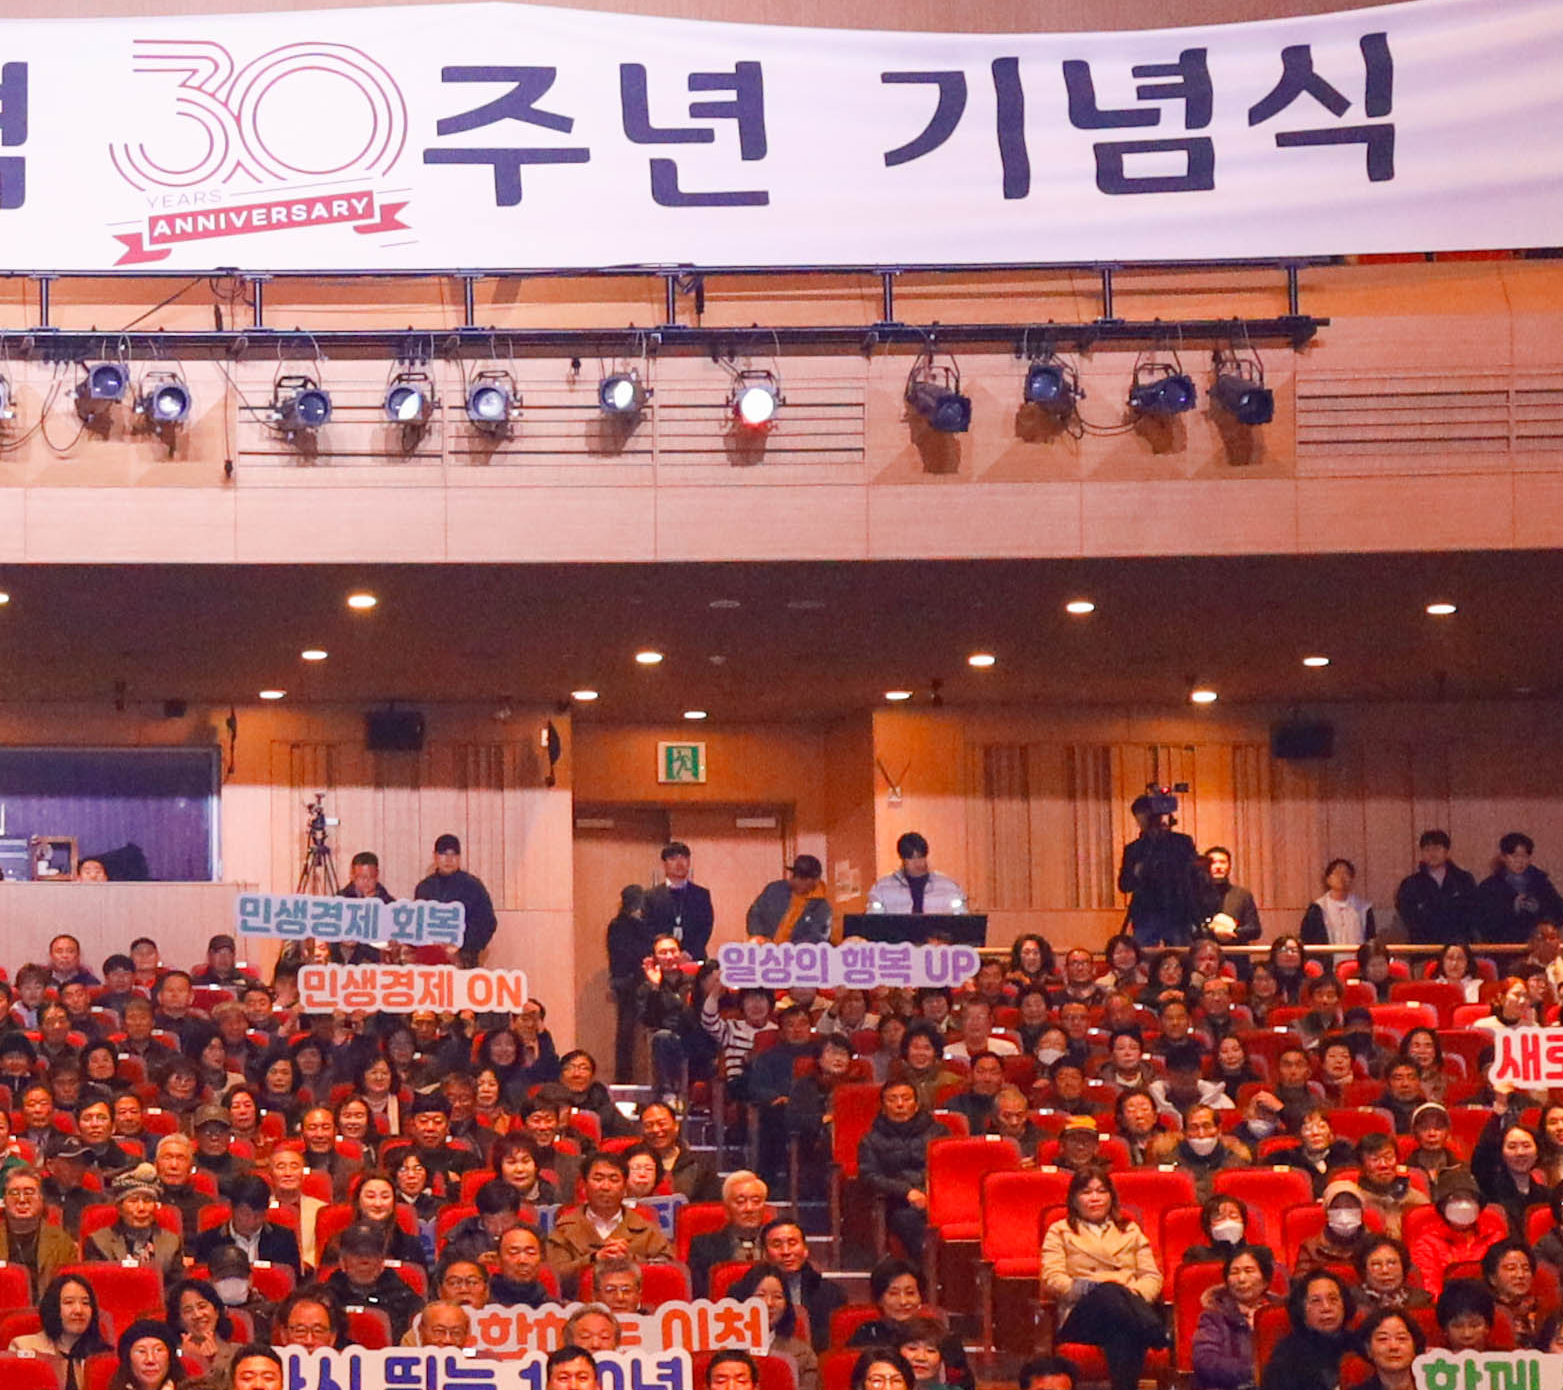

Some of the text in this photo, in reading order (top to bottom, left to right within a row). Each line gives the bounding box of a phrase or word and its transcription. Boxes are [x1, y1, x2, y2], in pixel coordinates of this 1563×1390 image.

[881, 28, 1397, 202] 기념식
[145, 189, 223, 210] YEARS
[152, 196, 370, 238] ANNIVERSARY
[238, 896, 462, 944] 민생경제 회복
[721, 945, 976, 986] 일상의 행복 UP
[301, 968, 525, 1010] 민생경제 ON
